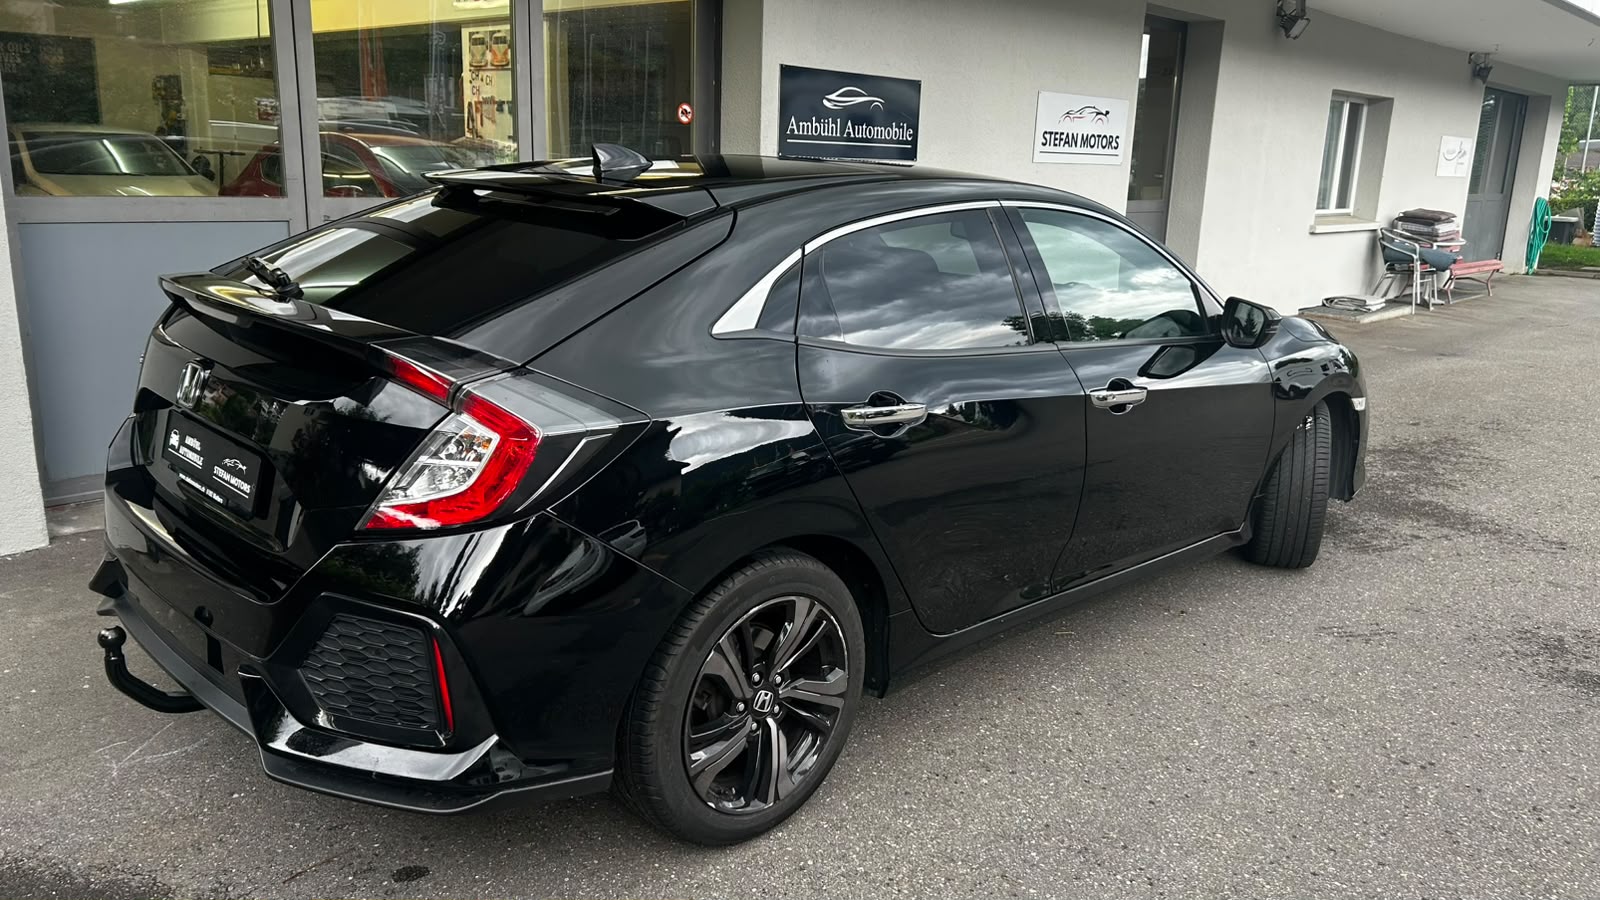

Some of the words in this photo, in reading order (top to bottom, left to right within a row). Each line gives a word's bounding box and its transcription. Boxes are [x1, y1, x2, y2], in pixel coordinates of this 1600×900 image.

[786, 116, 841, 137] Ambühl
[843, 120, 913, 141] Automobile
[1041, 131, 1078, 148] STEFAN
[1080, 133, 1120, 150] MOTORS
[213, 465, 231, 482] STEFAN
[229, 474, 251, 494] MOTORS
